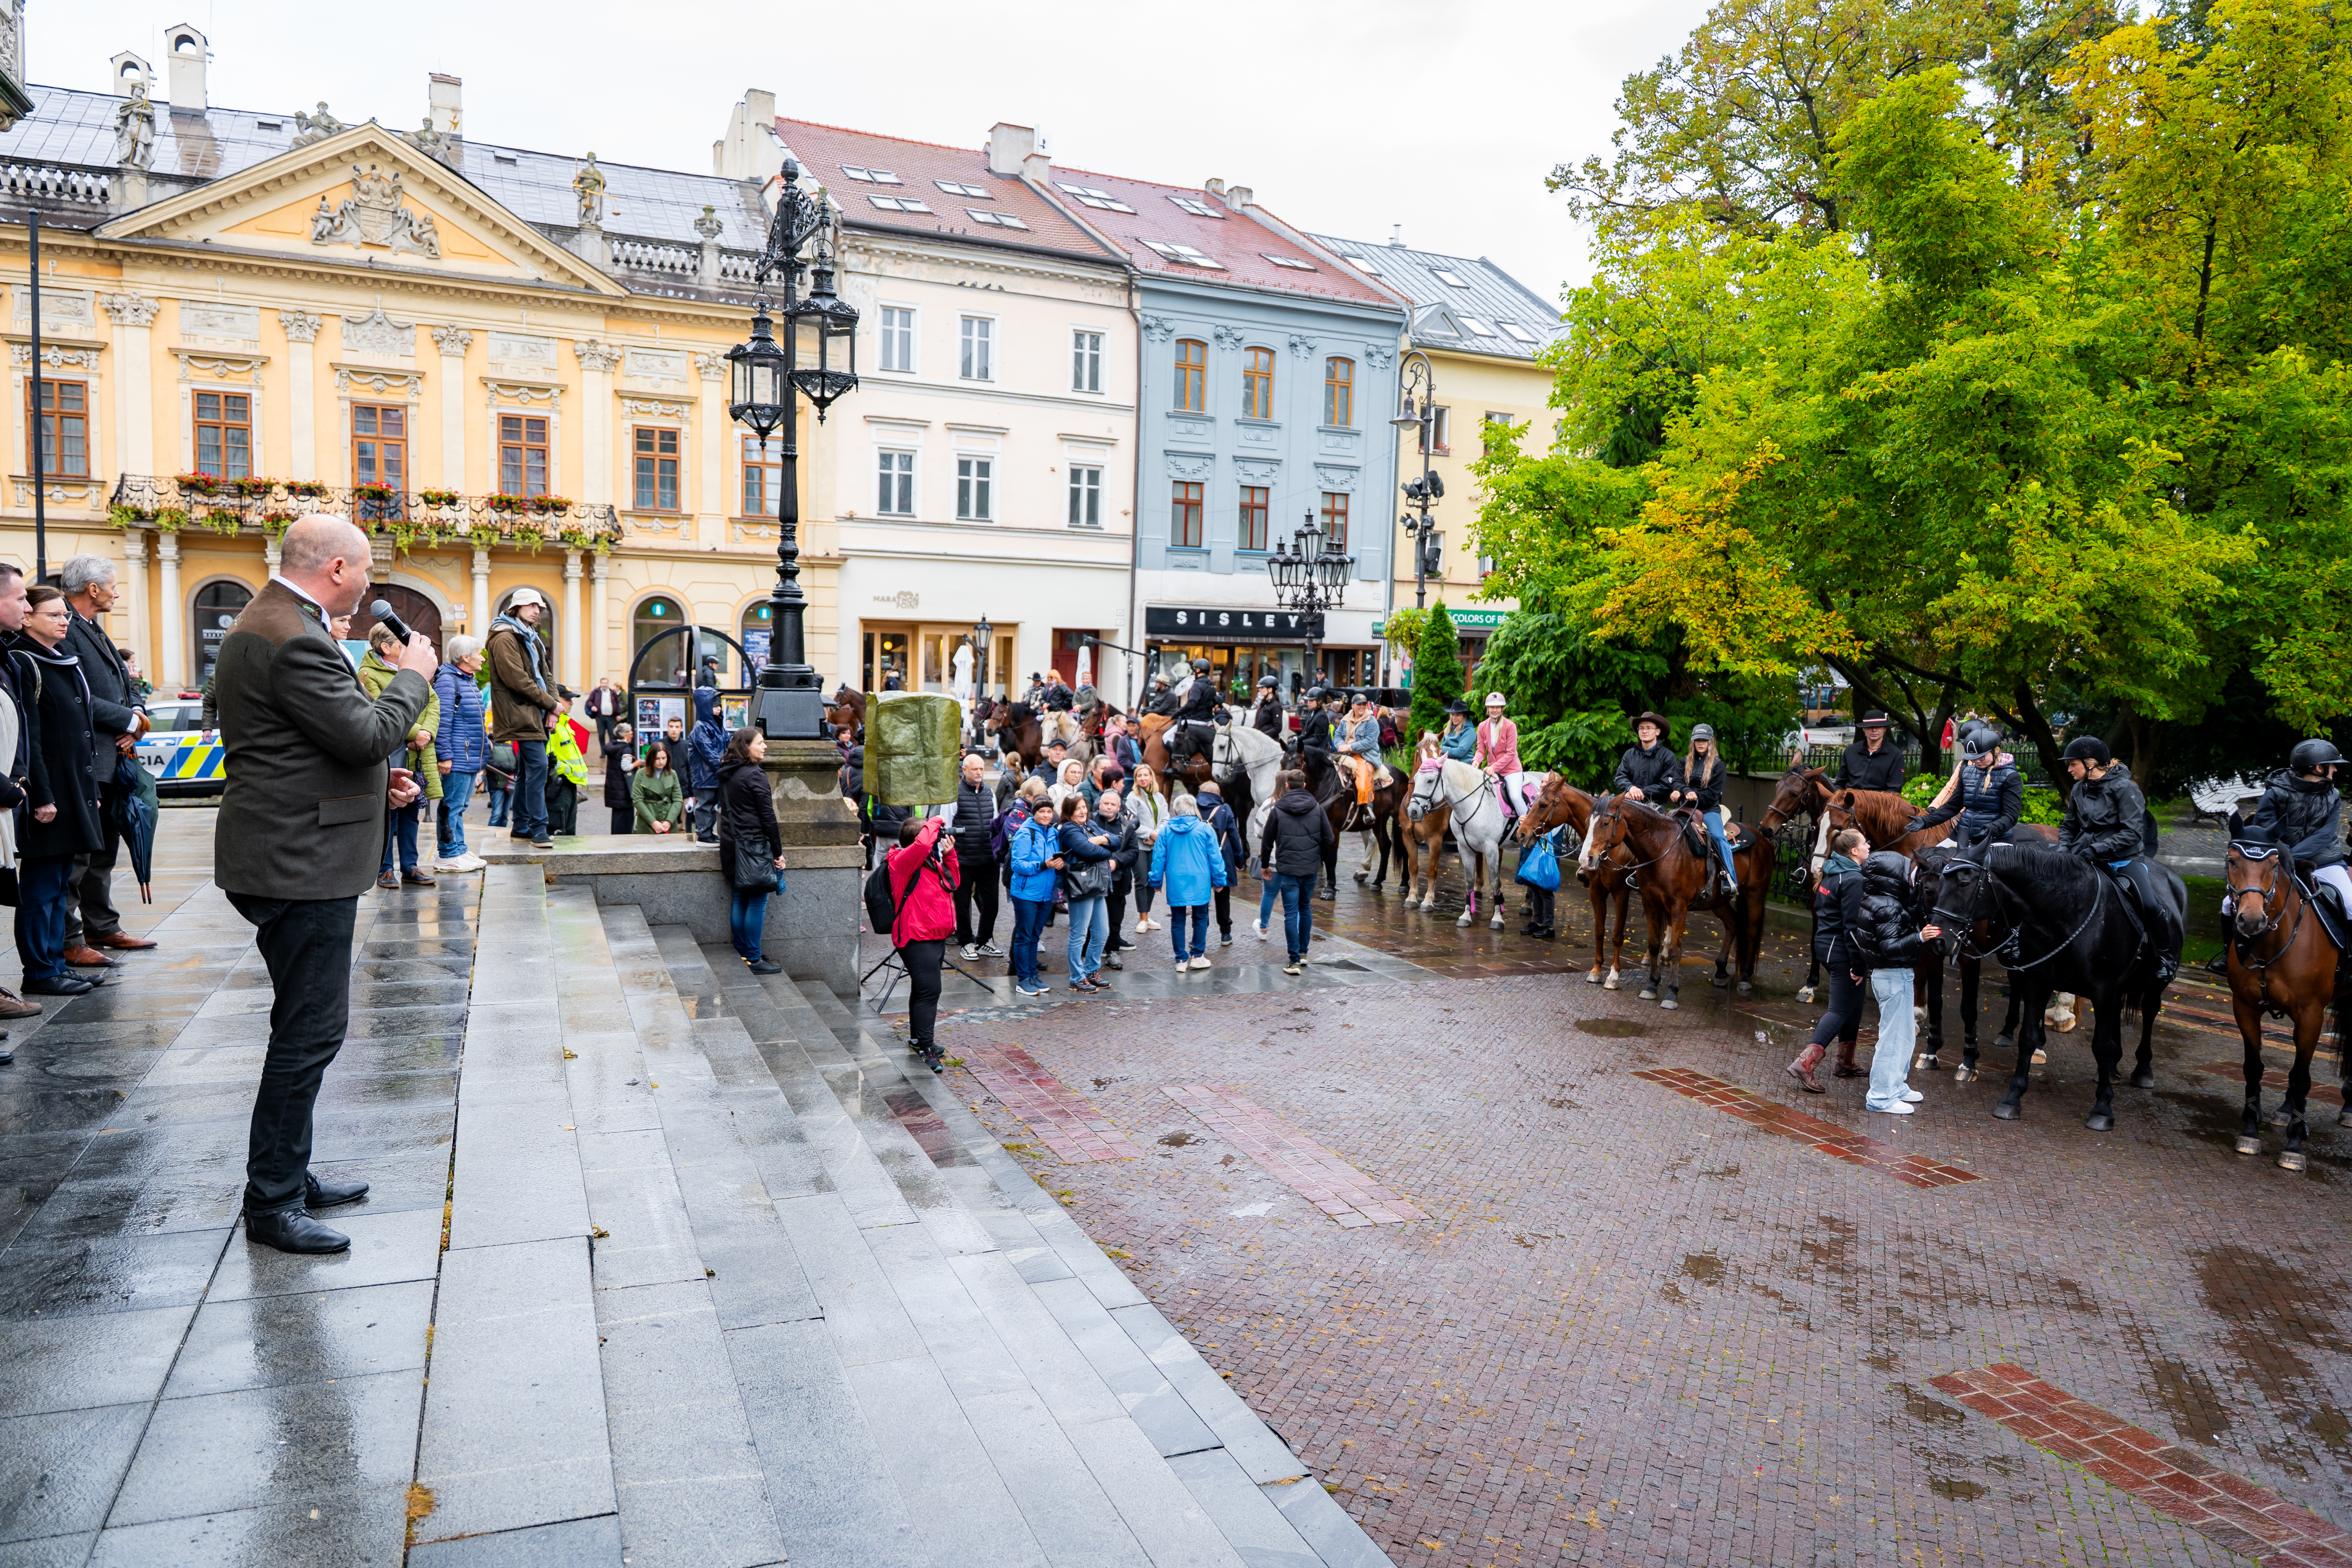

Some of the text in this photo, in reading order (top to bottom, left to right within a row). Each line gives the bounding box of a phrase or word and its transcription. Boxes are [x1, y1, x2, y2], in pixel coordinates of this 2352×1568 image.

[873, 594, 918, 604] MARATHON
[1176, 611, 1299, 628] SISLEY
[1452, 613, 1484, 624] COLORS
[1485, 615, 1496, 624] OF
